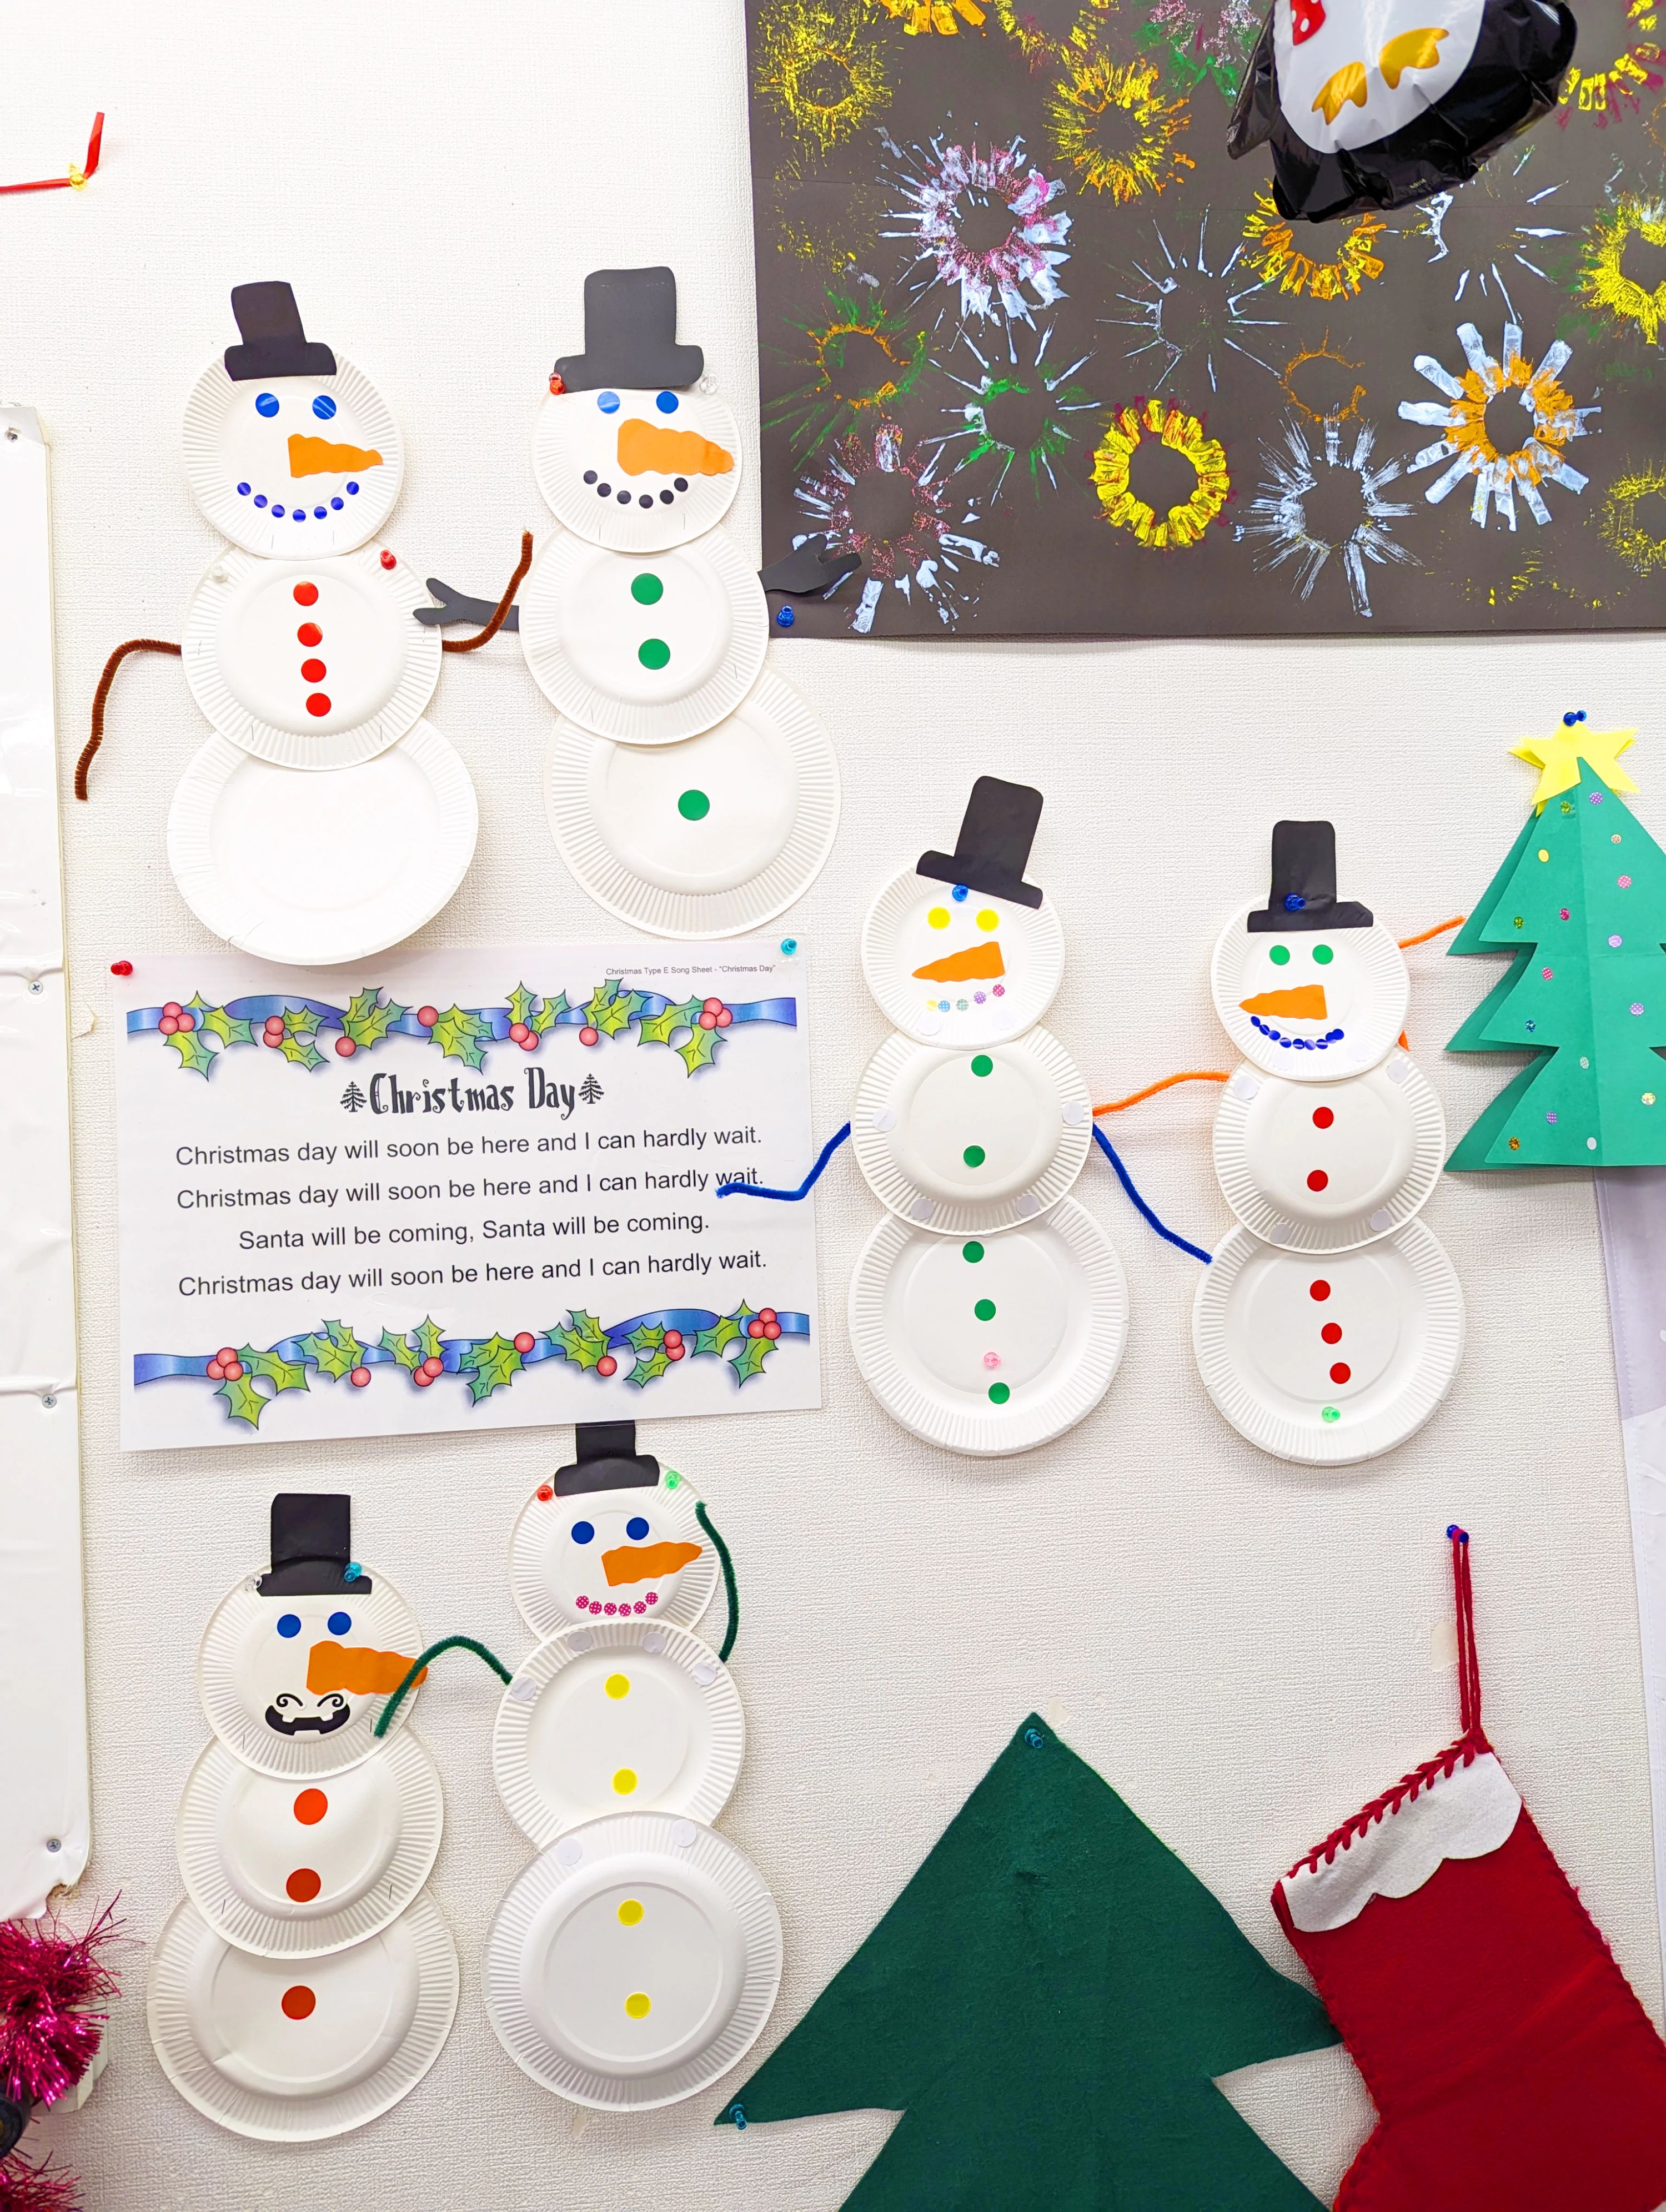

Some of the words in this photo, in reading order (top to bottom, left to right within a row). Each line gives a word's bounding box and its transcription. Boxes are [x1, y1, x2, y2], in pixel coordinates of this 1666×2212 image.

[644, 967, 661, 976] Type
[369, 1073, 514, 1115] Christmas
[524, 1067, 575, 1120] Day
[176, 1146, 289, 1165] Christmas
[298, 1142, 337, 1165] day
[344, 1140, 378, 1159] will
[387, 1142, 439, 1158] soon
[448, 1137, 473, 1155] be
[482, 1136, 529, 1154] here
[538, 1132, 576, 1152] and
[585, 1132, 590, 1150] I
[598, 1135, 635, 1149] can
[644, 1128, 707, 1150] hardly
[714, 1125, 761, 1144] wait.
[177, 1189, 291, 1209] Christmas
[299, 1185, 339, 1208] day
[345, 1183, 379, 1201] will
[388, 1185, 440, 1200] soon
[449, 1180, 475, 1198] be
[483, 1178, 531, 1196] here
[539, 1174, 578, 1194] and
[586, 1174, 591, 1192] I
[599, 1177, 636, 1191] can
[645, 1169, 709, 1192] hardly
[715, 1167, 763, 1186] wait.
[239, 1230, 304, 1250] Santa
[312, 1226, 345, 1246] will
[354, 1226, 381, 1244] be
[389, 1223, 473, 1245] coming,
[483, 1219, 545, 1239] Santa
[552, 1216, 585, 1235] will
[594, 1215, 619, 1234] be
[627, 1212, 709, 1234] coming.
[179, 1275, 293, 1296] Christmas
[301, 1271, 341, 1294] day
[348, 1268, 382, 1288] will
[391, 1270, 443, 1286] soon
[452, 1265, 478, 1283] be
[486, 1263, 534, 1281] here
[541, 1259, 581, 1279] and
[589, 1258, 594, 1276] I
[603, 1260, 640, 1275] can
[648, 1253, 712, 1275] hardly
[719, 1249, 766, 1269] wait.
